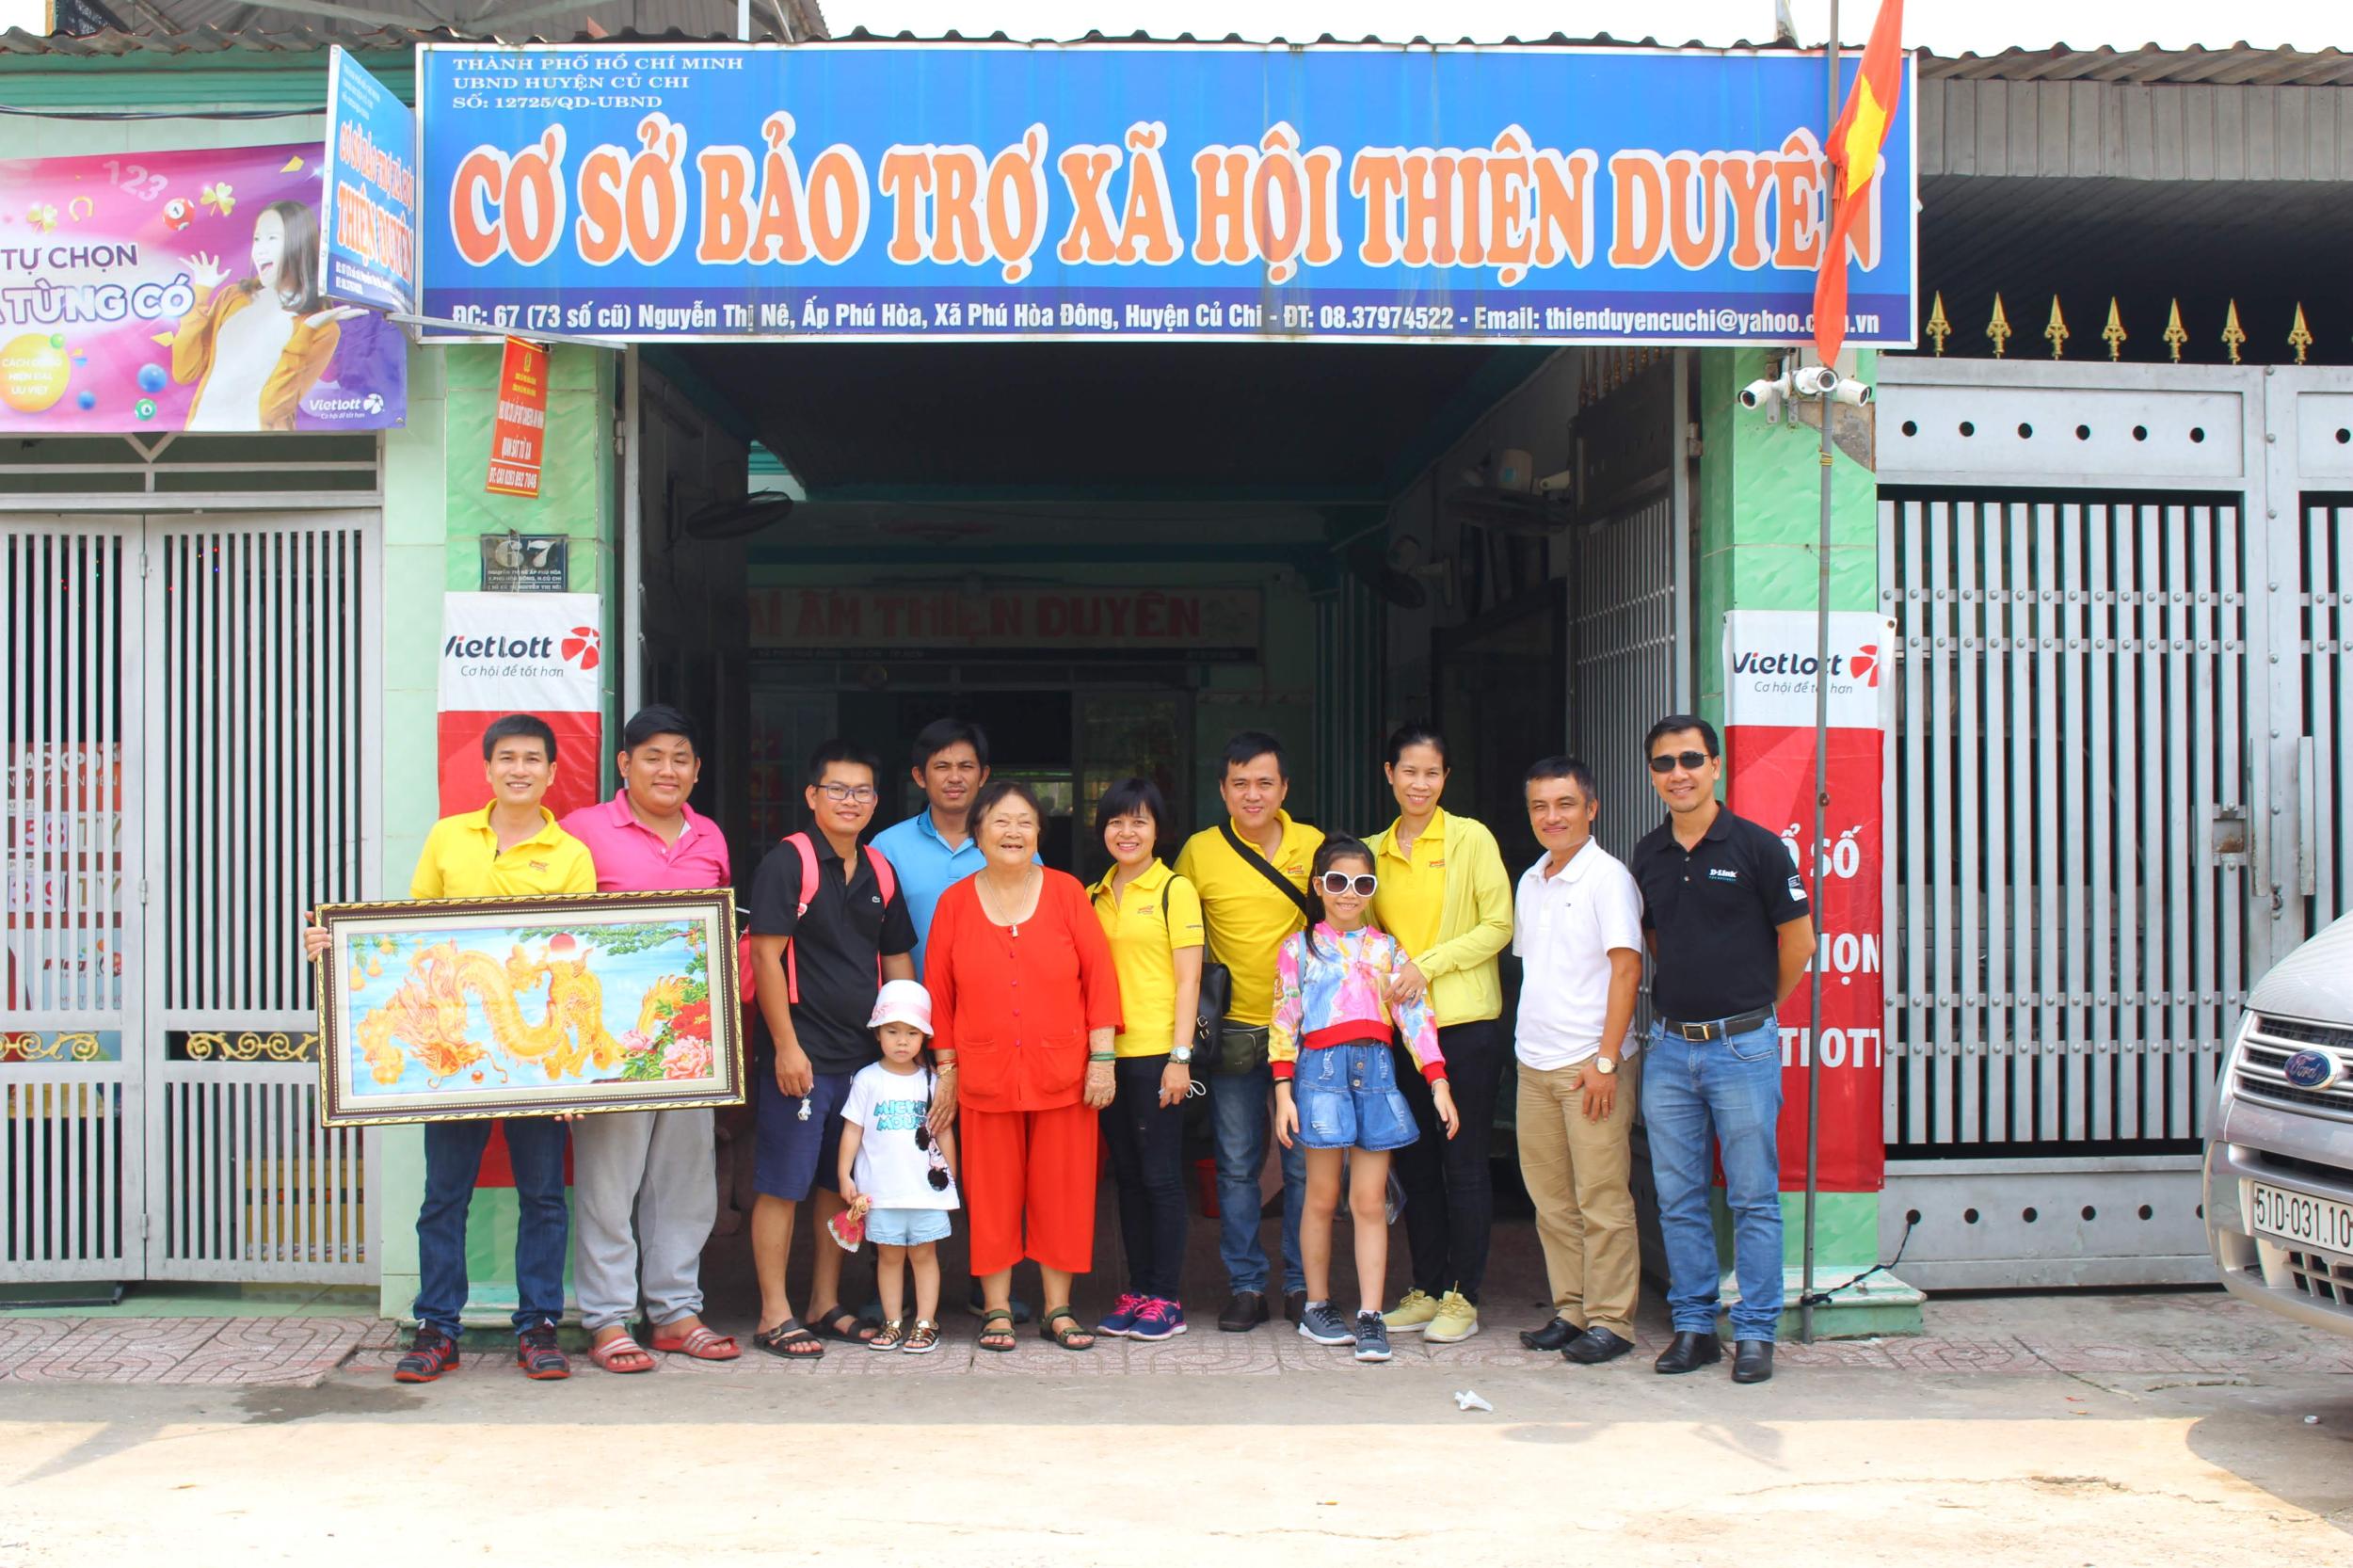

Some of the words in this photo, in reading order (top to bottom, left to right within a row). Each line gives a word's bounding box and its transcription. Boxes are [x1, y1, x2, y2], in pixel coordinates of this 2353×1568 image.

[453, 56, 534, 71] THÀNH
[540, 55, 588, 71] PHỐ
[595, 54, 628, 70] HỒ
[634, 56, 676, 70] CHÍ
[681, 57, 744, 70] MINH
[453, 76, 519, 89] UBND
[524, 73, 604, 91] HUYỆN
[610, 72, 643, 89] CỦ
[648, 76, 690, 88] CHI
[452, 92, 488, 109] SỐ:
[103, 160, 169, 201] 123
[450, 123, 567, 267] CƠ
[576, 112, 688, 266] SỞ
[696, 111, 870, 266] BẢO
[883, 122, 1048, 284] TRỢ
[1058, 120, 1183, 266] XÃ
[1192, 120, 1343, 286] HỘI
[1351, 124, 1598, 287] THIỆN
[0, 247, 42, 276] TỰ
[48, 245, 138, 273] CHỌN
[2, 278, 128, 325] TỪNG
[131, 273, 196, 320] CÓ
[453, 305, 488, 326] ĐC:
[494, 305, 520, 328] 67
[527, 305, 562, 330] (73
[567, 300, 595, 328] số
[598, 305, 632, 330] cũ)
[638, 300, 717, 331] Nguyễn
[723, 303, 754, 331] Thị
[761, 304, 795, 330] Nê,
[802, 296, 829, 329] Ấp
[836, 303, 876, 328] Phú
[883, 303, 928, 329] Hòa,
[934, 303, 962, 327] Xã
[968, 303, 1008, 328] Phú
[1015, 303, 1054, 327] Hòa
[1059, 303, 1119, 331] Đông,
[1125, 304, 1190, 332] Huyện
[1195, 300, 1223, 328] Củ
[1228, 304, 1262, 328] Chi
[1284, 305, 1315, 328] ĐT:
[1320, 306, 1454, 329] 08.37974522
[1474, 307, 1540, 330] Email:
[1545, 307, 1880, 335] thienduyencuchi@yahoo.c.vn
[309, 398, 361, 411] Vietlott
[495, 539, 557, 568] 67
[1036, 589, 1201, 639] DUYÊN
[461, 664, 476, 677] Cơ
[480, 664, 499, 679] hội
[502, 664, 519, 677] để
[520, 664, 537, 677] tốt
[540, 665, 564, 678] hơn
[1733, 651, 1843, 676] Vietlot
[1754, 681, 1770, 693] Cơ
[1772, 680, 1791, 695] hội
[1794, 680, 1808, 694] để
[1831, 682, 1853, 695] hơn
[1709, 868, 1738, 878] D-Link
[2289, 1054, 2321, 1082] Ford
[2255, 1188, 2351, 1249] 51D-031.10
